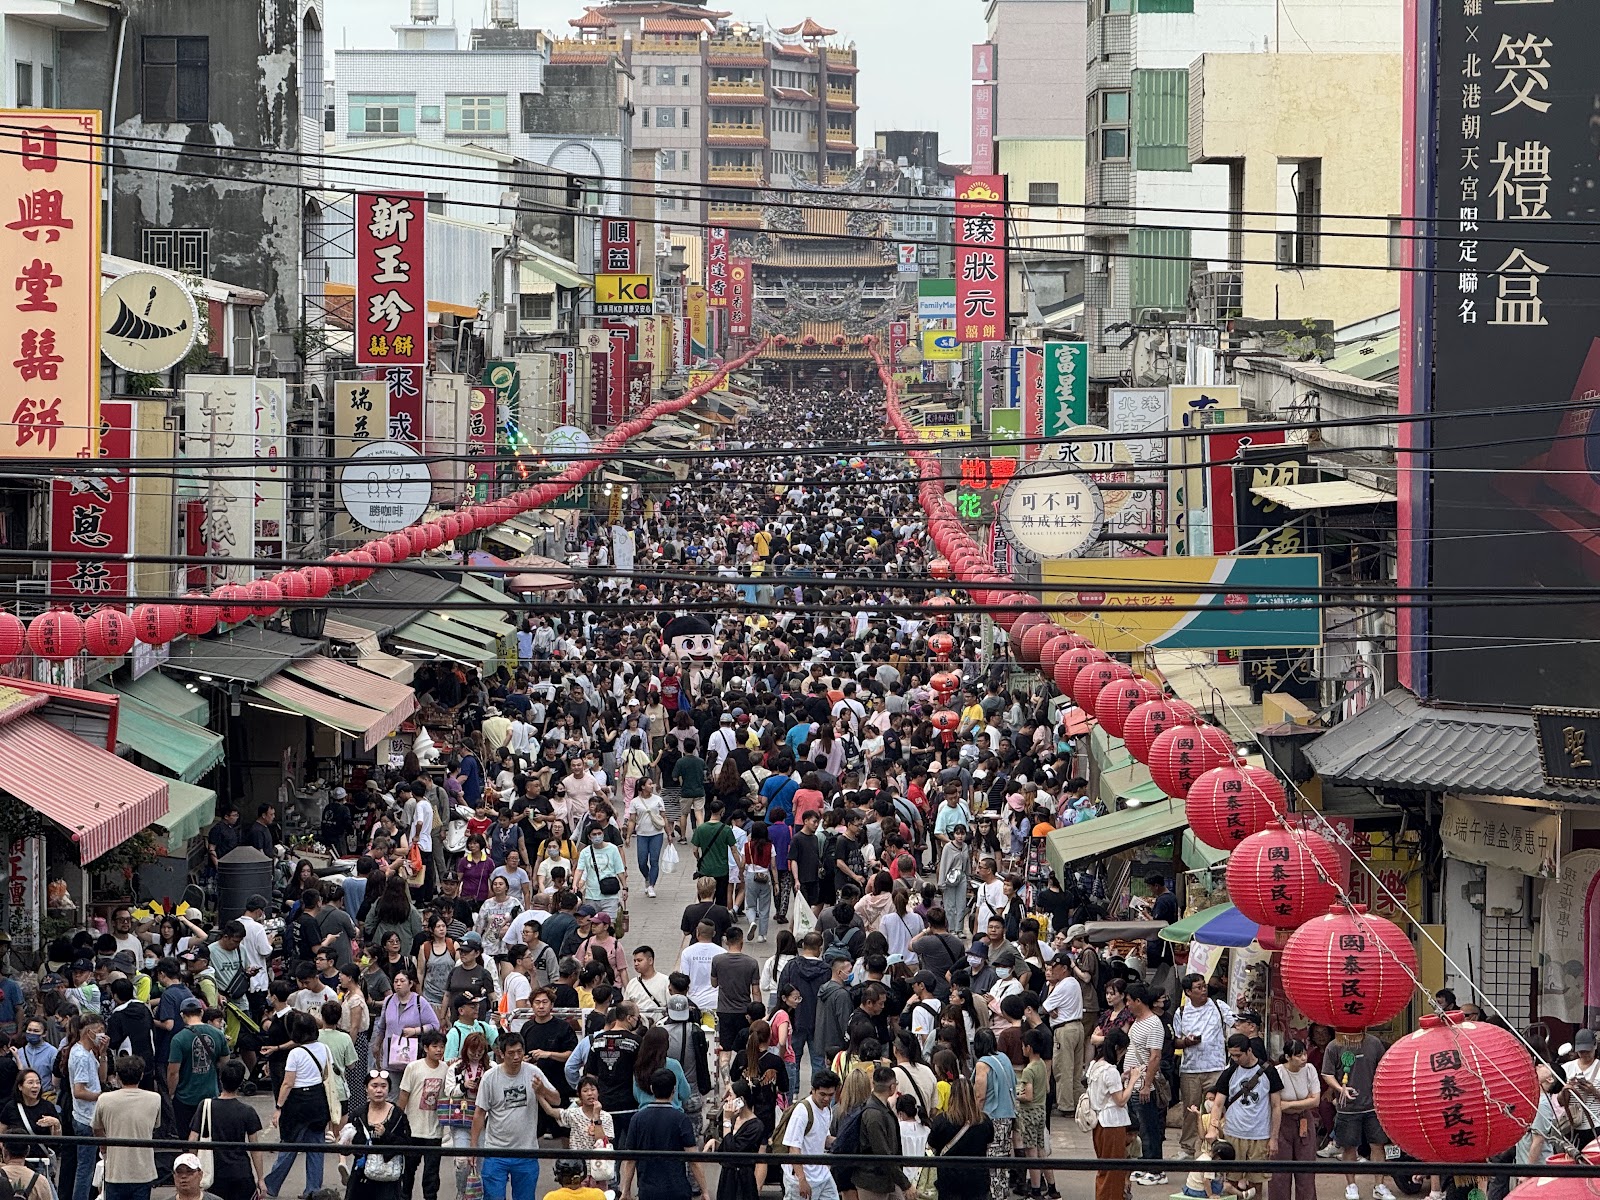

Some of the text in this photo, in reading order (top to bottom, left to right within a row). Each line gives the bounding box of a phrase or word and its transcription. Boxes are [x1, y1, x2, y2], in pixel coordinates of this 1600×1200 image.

[1487, 0, 1553, 326] 筊禮盒
[368, 197, 415, 333] 新玉珍
[608, 222, 630, 270] 順益
[962, 212, 998, 318] 臻狀元
[5, 124, 74, 452] 日興堂囍餅
[368, 335, 414, 357] 囍餅
[1118, 395, 1161, 412] 北港
[1058, 442, 1115, 463] 永川
[369, 504, 404, 518] 勝咖啡
[1021, 491, 1082, 511] 可不可
[1021, 514, 1082, 528] 熟成紅茶
[1562, 725, 1592, 769] 聖
[1223, 780, 1247, 840] 國泰民安
[1453, 815, 1548, 859] 端午禮盒優惠中
[1267, 846, 1293, 916] 國泰民安
[1339, 934, 1366, 1016] 國泰民安
[1430, 1049, 1478, 1148] 國泰民安
